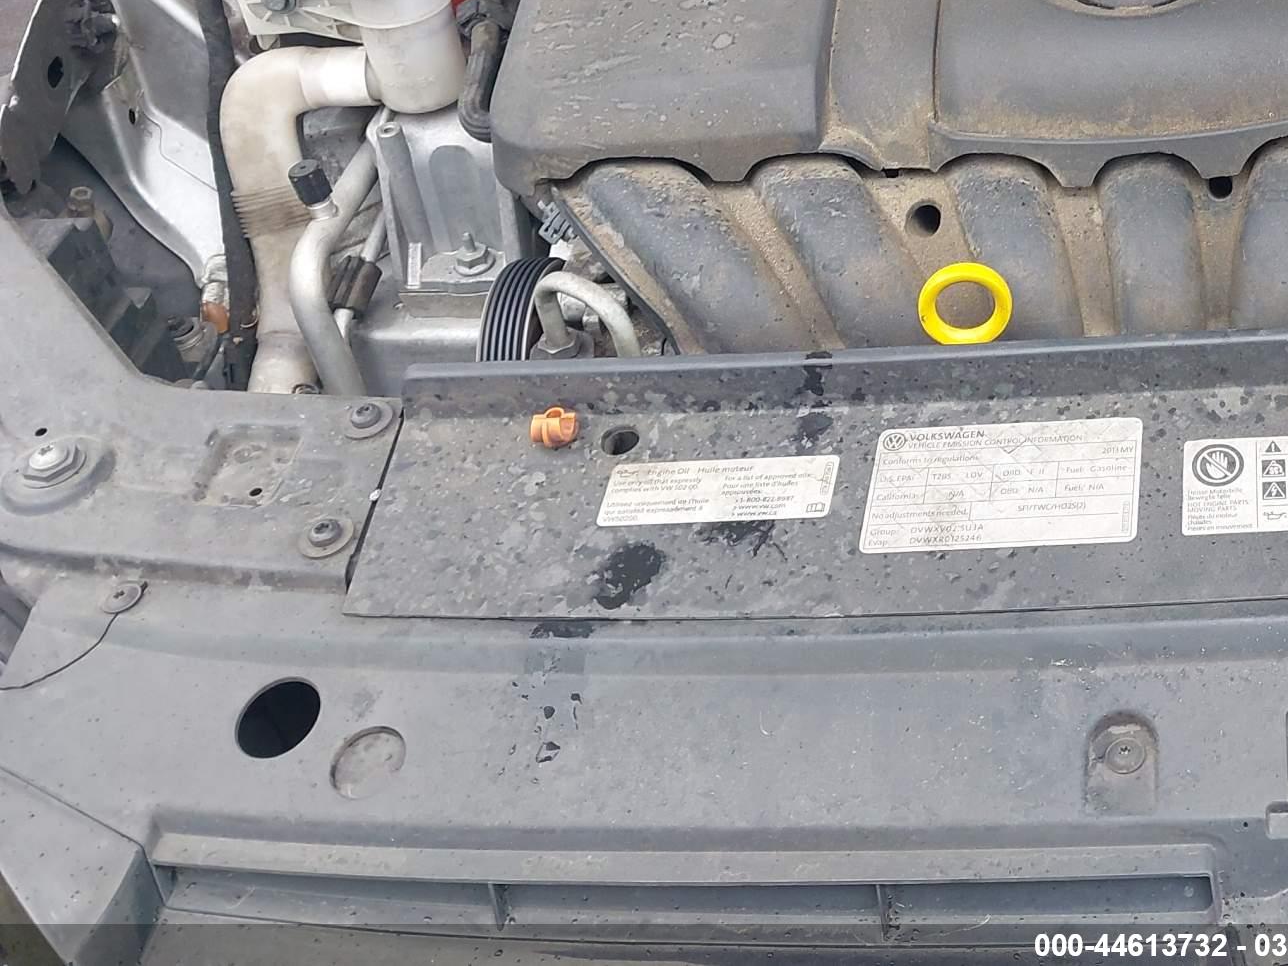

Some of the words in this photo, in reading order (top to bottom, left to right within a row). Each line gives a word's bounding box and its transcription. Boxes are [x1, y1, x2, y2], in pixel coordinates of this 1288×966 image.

[910, 430, 985, 442] VOLKSWAGEN
[908, 442, 941, 450] VEHICLE
[943, 440, 983, 448] EMISSION
[984, 437, 1021, 446] CONTROL
[1024, 434, 1083, 443] INFORMATION
[647, 468, 676, 477] Engine
[677, 466, 690, 475] Oil
[697, 465, 720, 474] Huile
[722, 465, 754, 473] moteur
[1090, 464, 1128, 473] Gasoline
[764, 473, 798, 482] approved
[1028, 486, 1044, 494] N/A
[1088, 483, 1105, 491] N/A
[871, 512, 884, 520] No
[885, 510, 934, 521] adjustments
